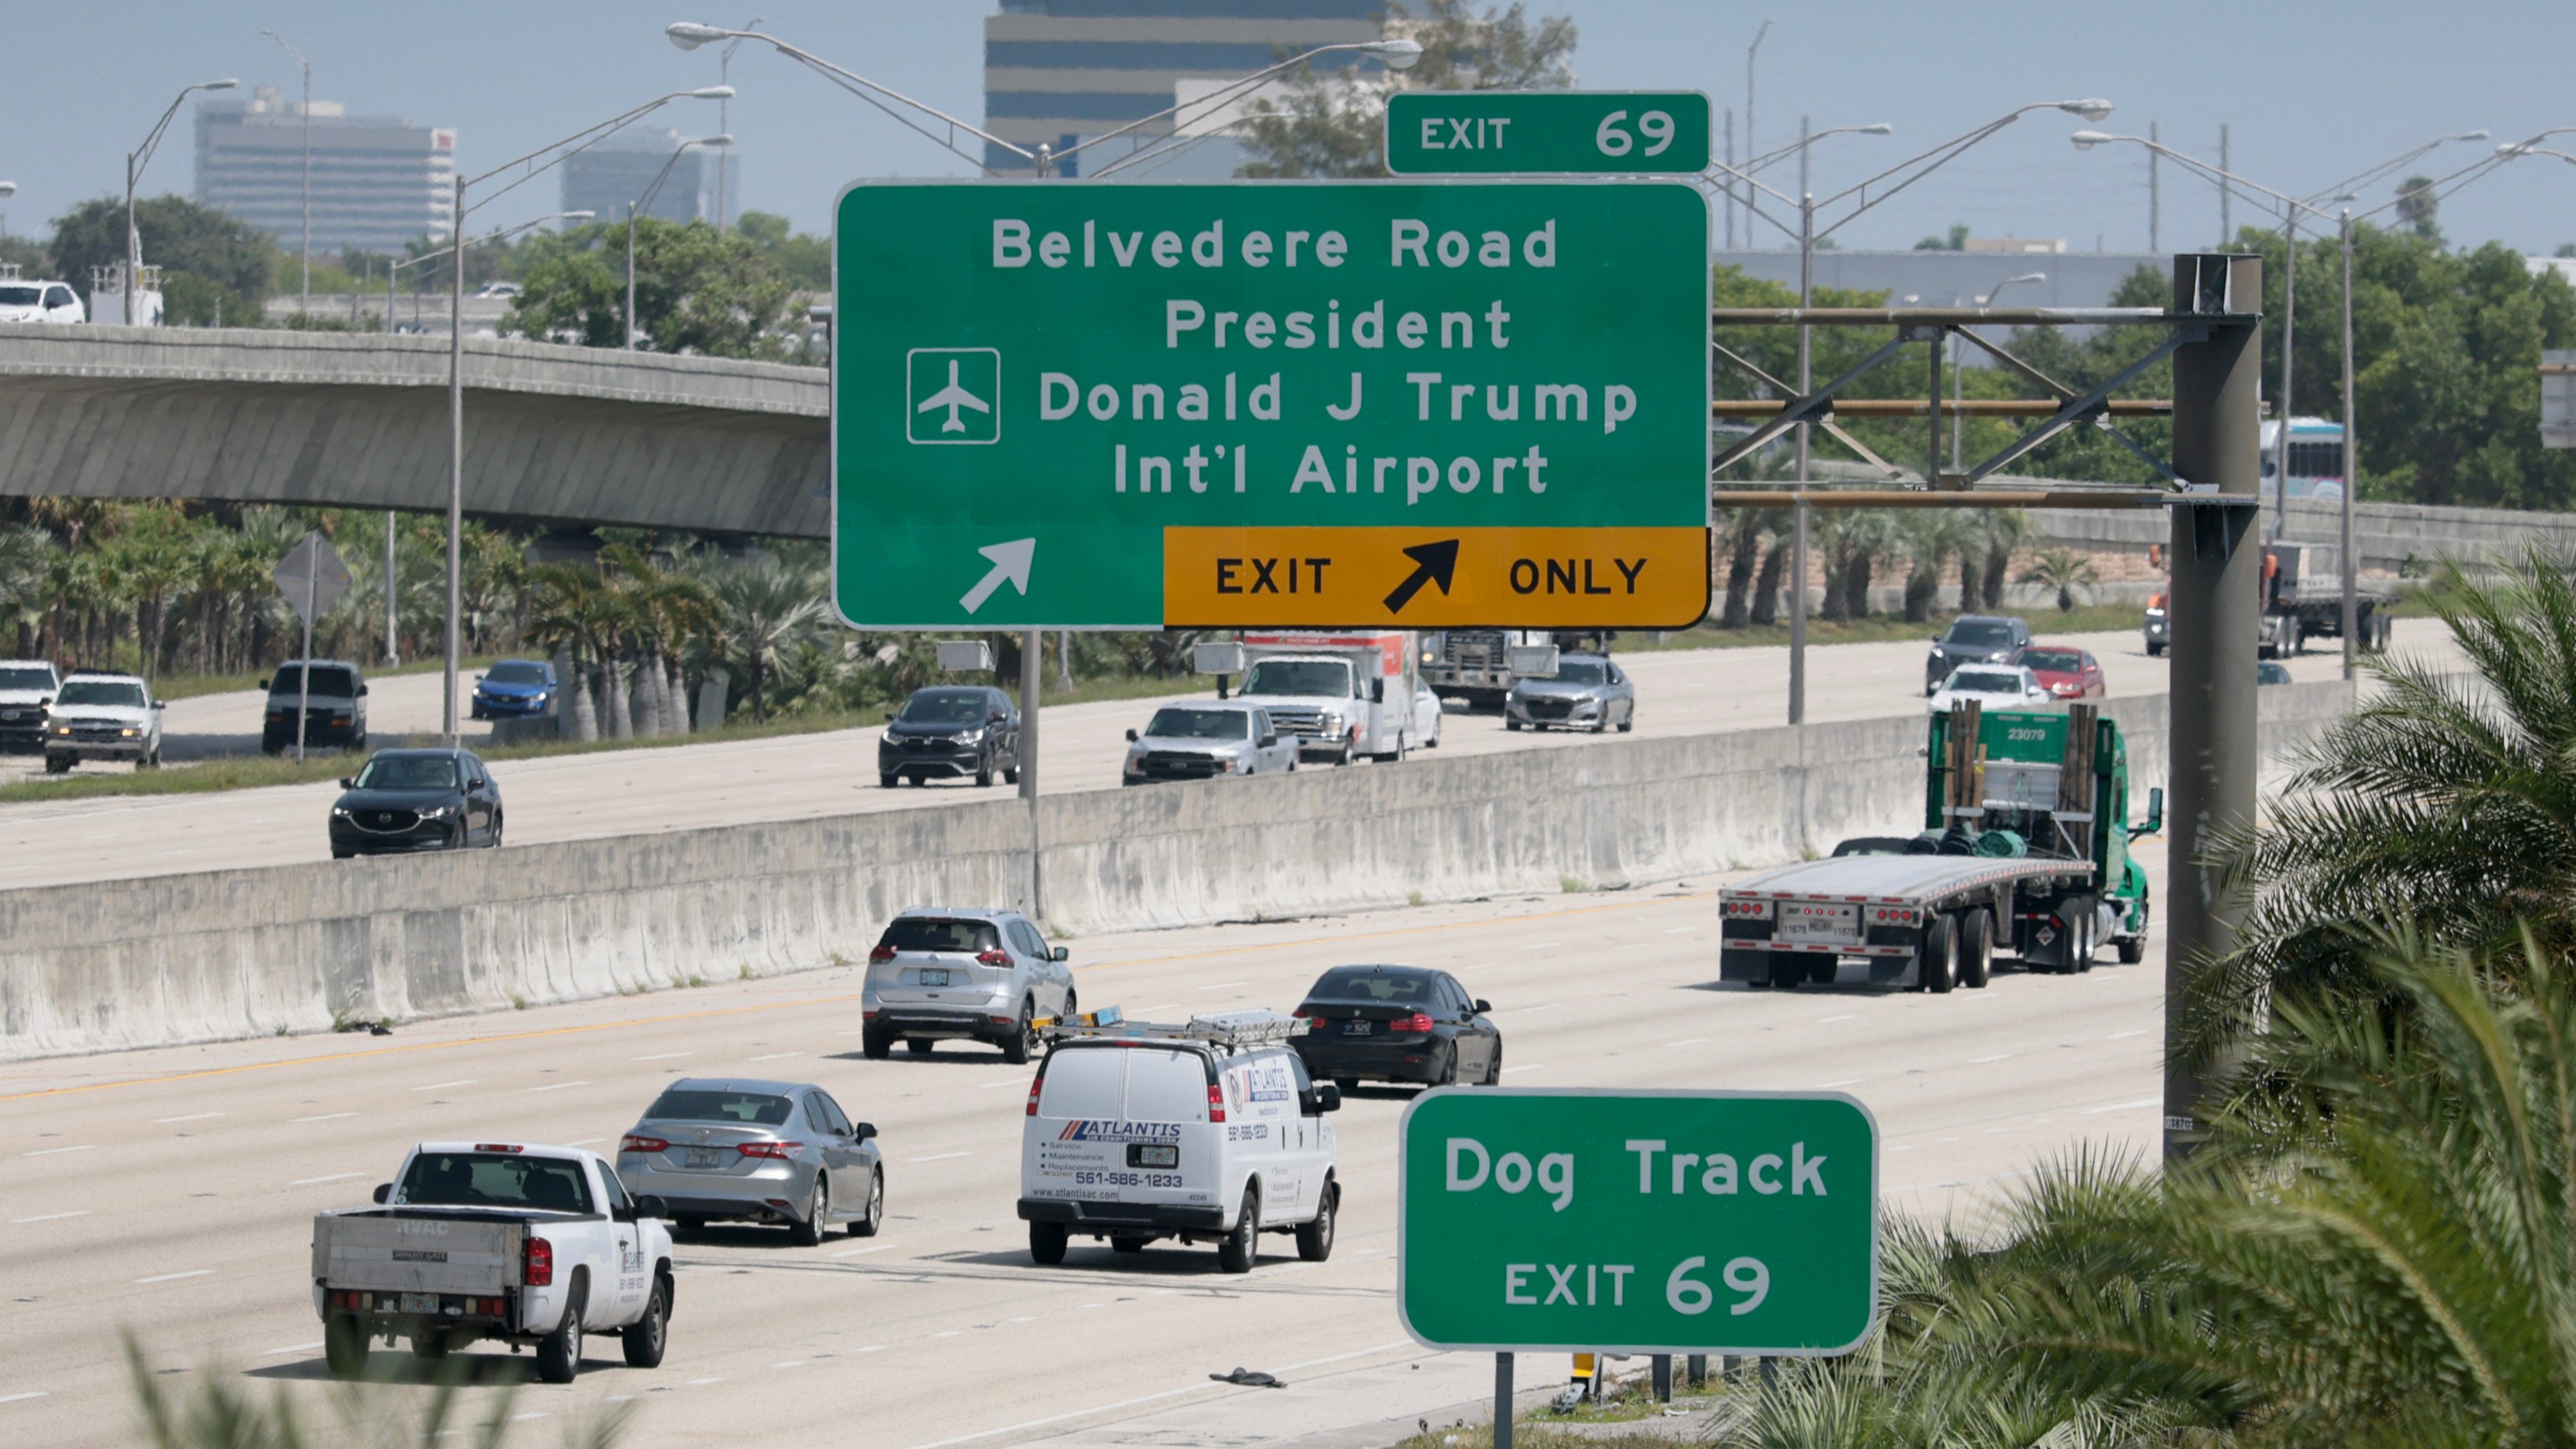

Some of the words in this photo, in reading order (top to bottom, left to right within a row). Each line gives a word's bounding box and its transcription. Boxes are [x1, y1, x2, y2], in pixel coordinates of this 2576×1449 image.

[1421, 118, 1510, 148] EXIT
[1596, 110, 1675, 156] 69
[992, 219, 1348, 268] Belvedere
[1391, 219, 1556, 268] Road
[1166, 299, 1511, 348] President
[1041, 372, 1280, 421] Donald
[1326, 372, 1362, 420] J
[1406, 372, 1637, 434] Trump
[1115, 444, 1246, 493] Int'l
[1290, 444, 1547, 505] Airport
[1217, 558, 1331, 594] EXIT
[1510, 558, 1647, 595] ONLY
[2007, 728, 2046, 741] 23079
[1087, 1121, 1181, 1136] ATLANTIS
[1048, 1141, 1082, 1150] Service
[1100, 1135, 1154, 1144] CONDITIONING
[1048, 1152, 1104, 1161] Maintenance
[1047, 1163, 1109, 1172] Replacements
[1446, 1138, 1574, 1212] Dog
[1625, 1140, 1828, 1195] Track
[1075, 1171, 1183, 1188] 561-586-1233
[1033, 1188, 1119, 1200] www.atlantisac.com
[396, 1221, 449, 1235] HVAC
[1505, 1263, 1634, 1305] EXIT
[1666, 1256, 1770, 1316] 69
